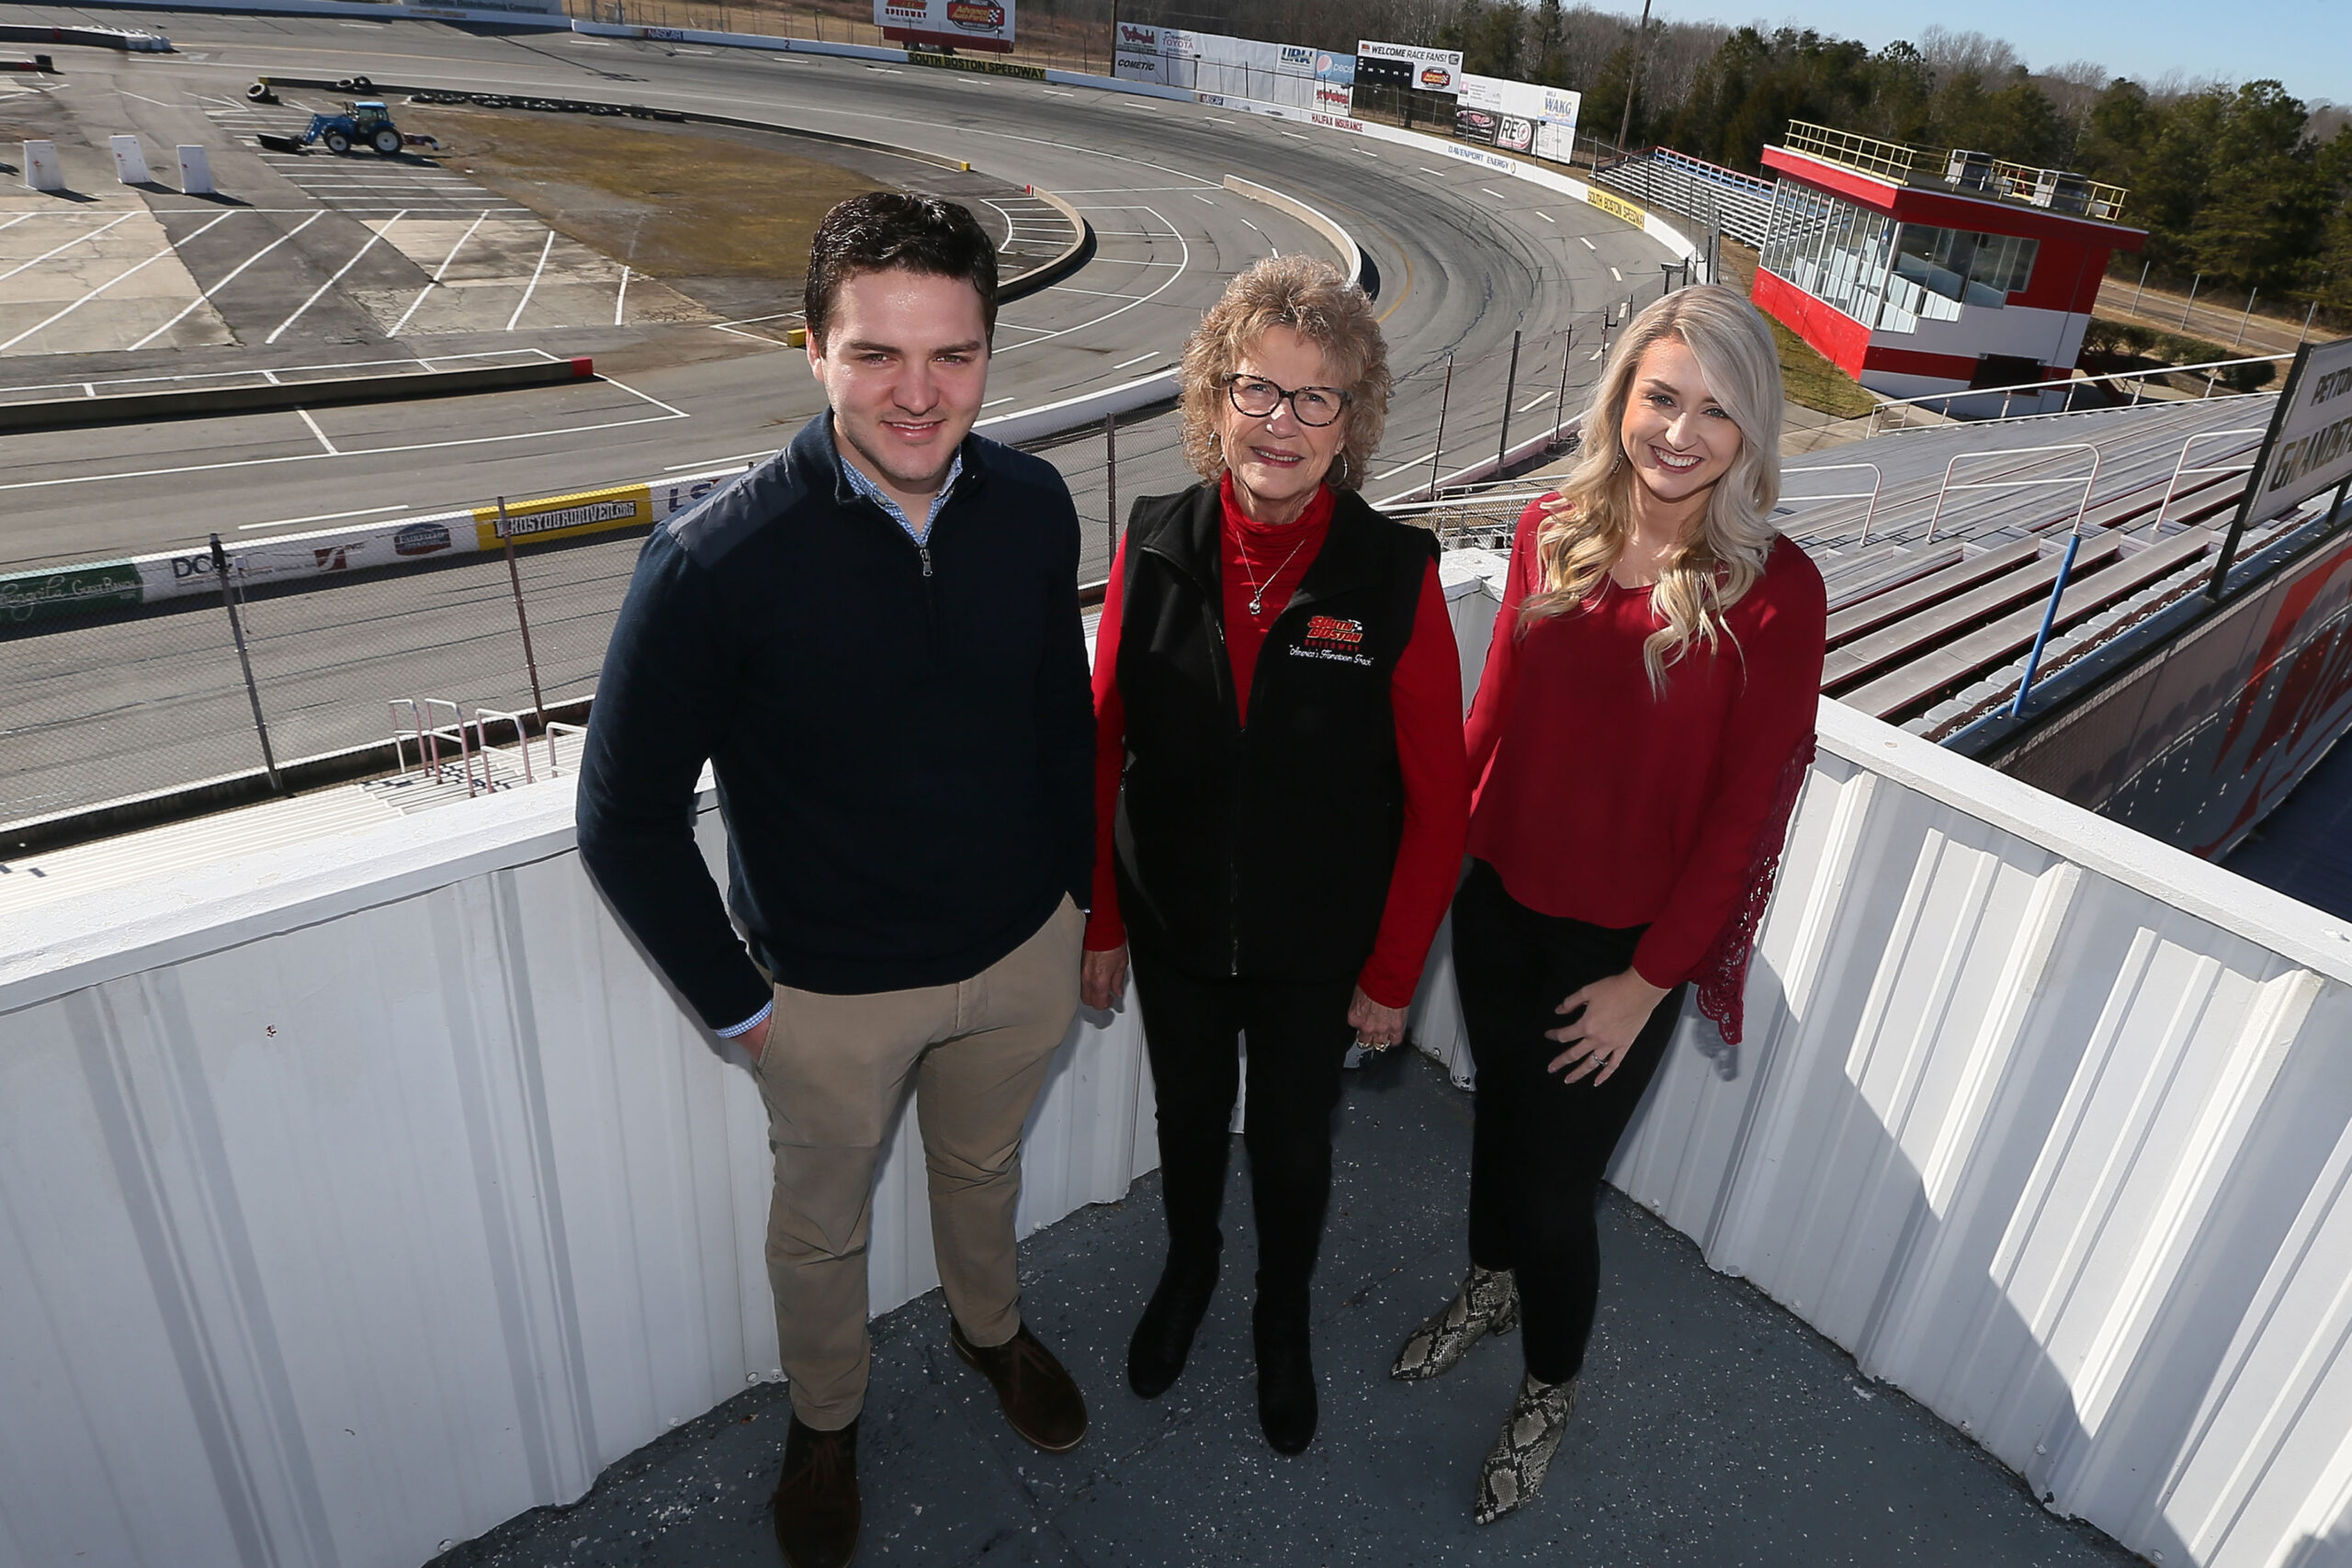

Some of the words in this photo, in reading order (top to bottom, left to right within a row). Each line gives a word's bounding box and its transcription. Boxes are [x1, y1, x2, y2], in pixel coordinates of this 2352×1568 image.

[647, 28, 684, 40] NASCAR
[784, 39, 791, 50] 2
[1161, 37, 1194, 50] TOYOTA
[1372, 45, 1406, 58] WELCOME
[1407, 49, 1425, 61] RACE
[1425, 51, 1448, 62] FANS!
[908, 52, 942, 67] SOUTH
[944, 56, 986, 72] BOSTON
[988, 62, 1046, 79] SPEEDWAY
[1117, 58, 1155, 72] COMETIC
[1544, 96, 1573, 115] WAKG
[1311, 113, 1333, 128] HALIFAX
[1335, 118, 1363, 132] INSURANCE
[1448, 145, 1484, 162] DAVENPORT
[1486, 155, 1509, 169] ENERGY
[1306, 615, 1354, 632] SOUTH
[1306, 628, 1363, 643] BOSTON
